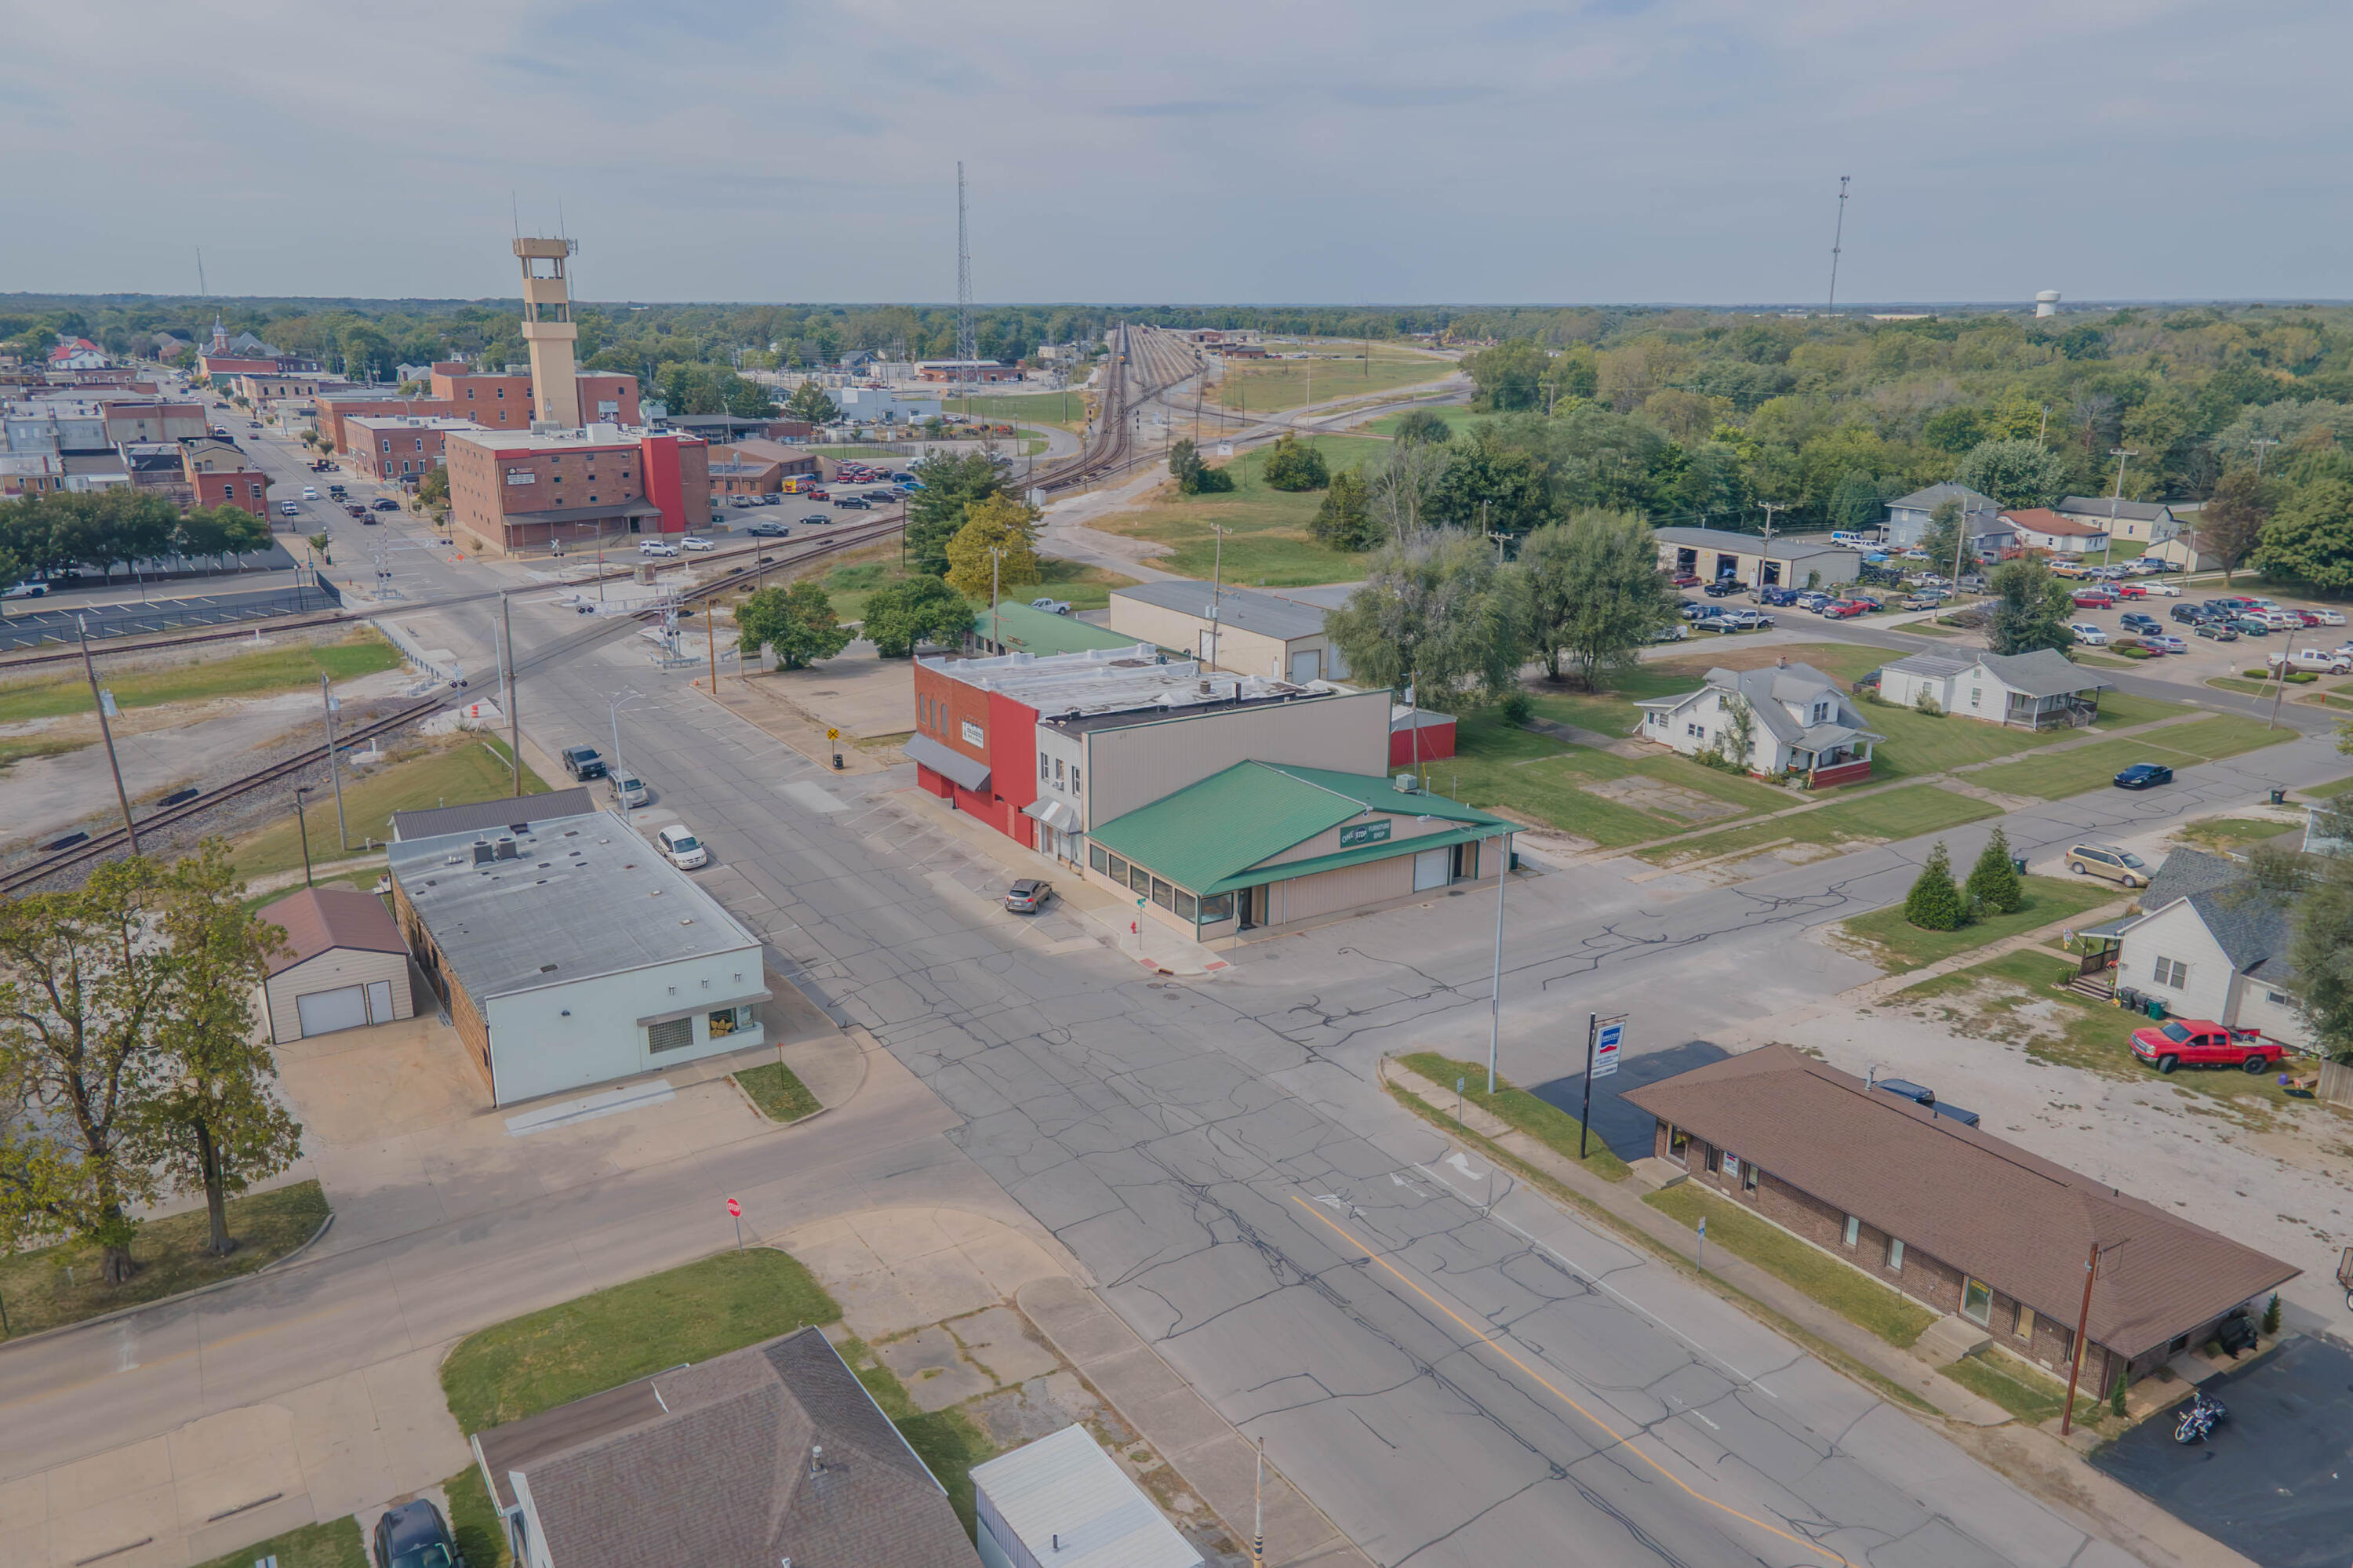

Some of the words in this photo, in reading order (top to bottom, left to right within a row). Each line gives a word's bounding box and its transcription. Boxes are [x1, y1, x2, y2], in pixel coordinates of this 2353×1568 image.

[1342, 831, 1355, 843] ONE
[1369, 822, 1390, 831] FURNITURE
[728, 1202, 740, 1212] STOP
